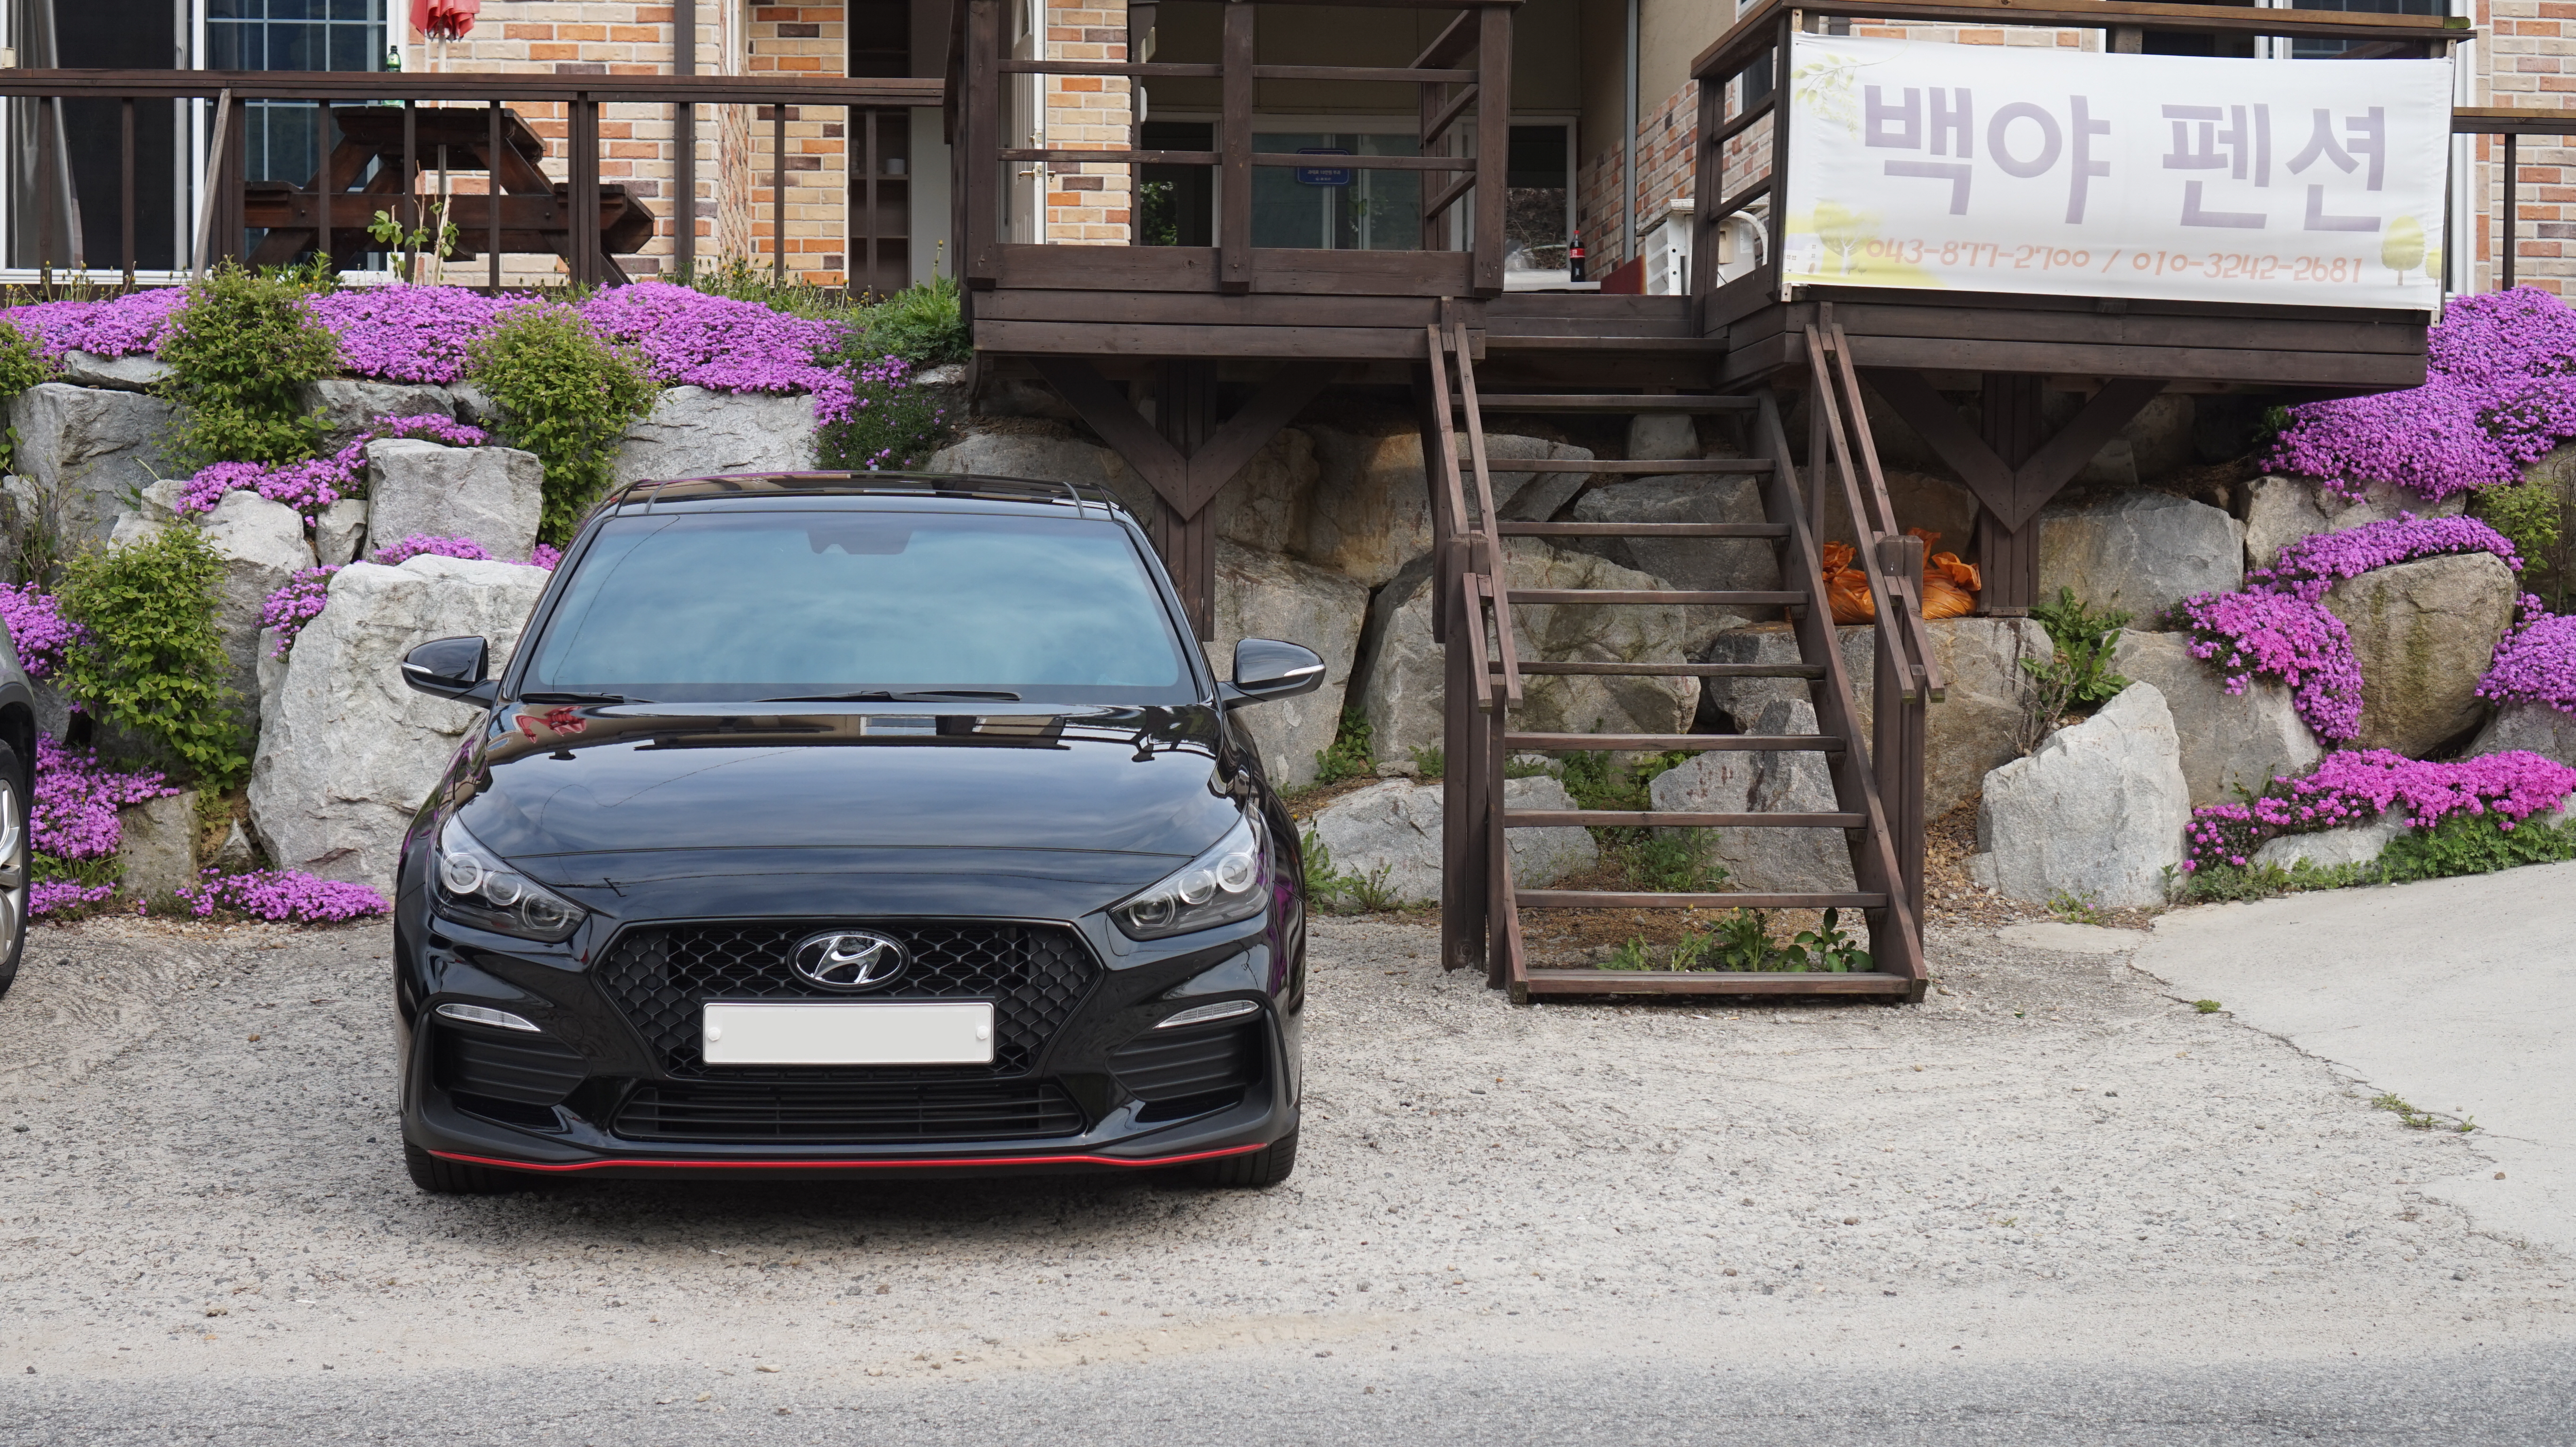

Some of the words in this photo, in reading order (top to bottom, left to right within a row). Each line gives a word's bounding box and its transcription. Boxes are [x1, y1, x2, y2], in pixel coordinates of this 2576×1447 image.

[1864, 85, 2111, 225] 백야
[2161, 103, 2386, 232] 펜션
[1866, 237, 2090, 270] 043-877-2700
[2132, 250, 2362, 283] 010-3242-2681
